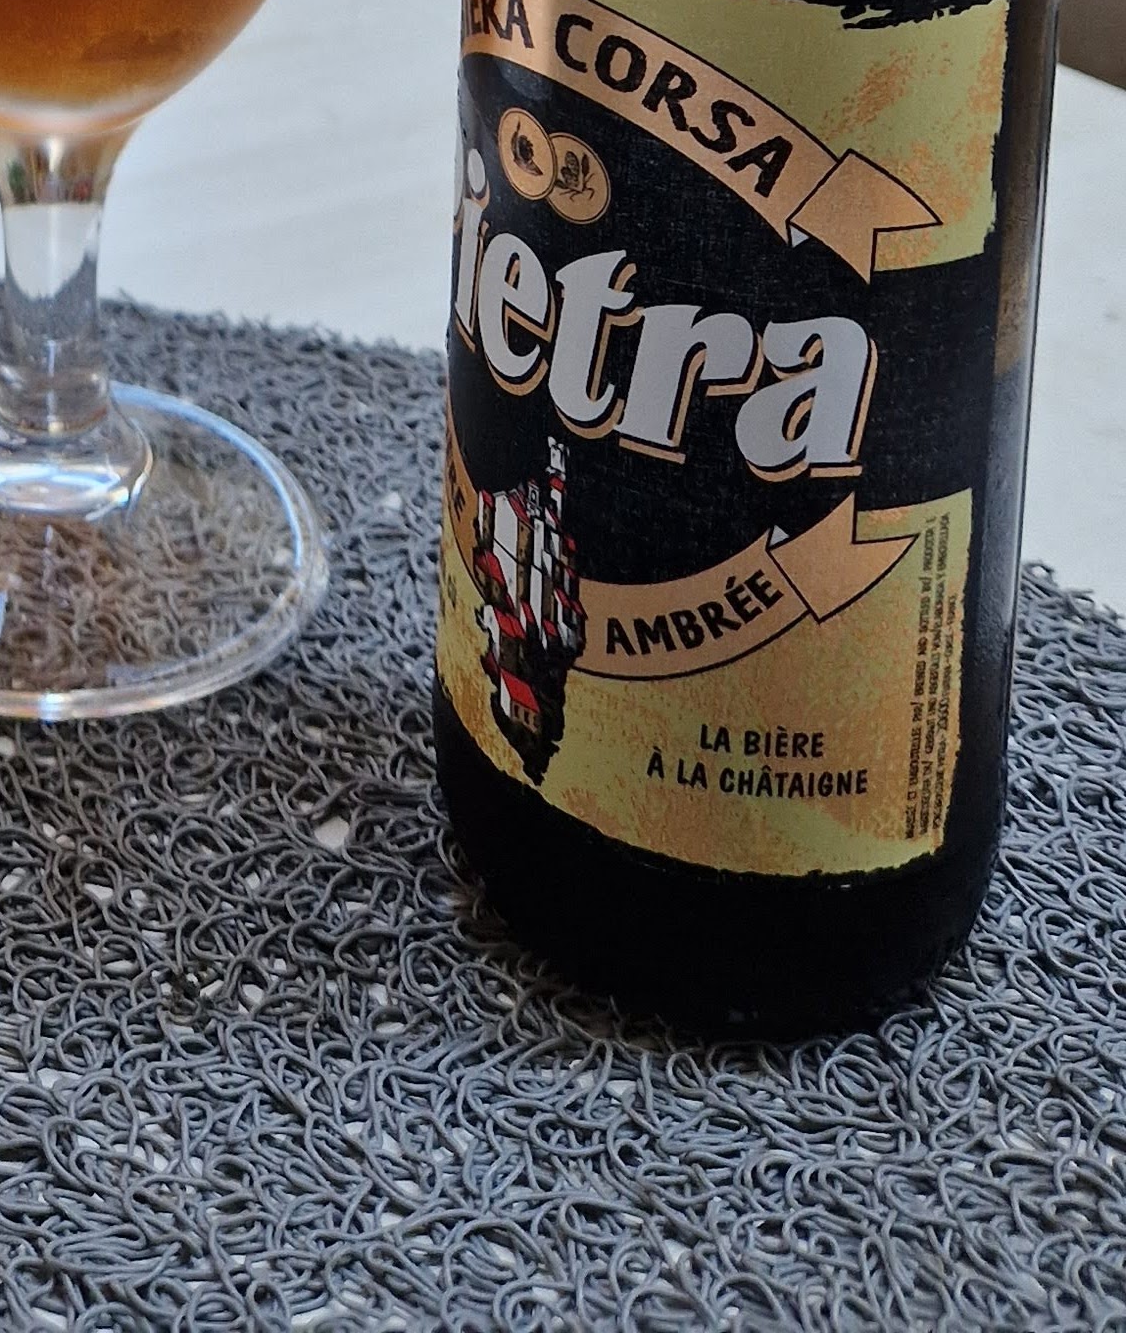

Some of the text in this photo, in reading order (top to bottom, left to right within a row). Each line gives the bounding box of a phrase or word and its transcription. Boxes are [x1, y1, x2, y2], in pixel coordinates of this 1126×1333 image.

[554, 13, 793, 198] CORSA
[454, 121, 876, 481] ietra
[605, 569, 784, 656] AMBRÉE
[646, 745, 868, 798] À LA CHÂTAIGNE
[699, 723, 824, 758] LA BIÈRE
